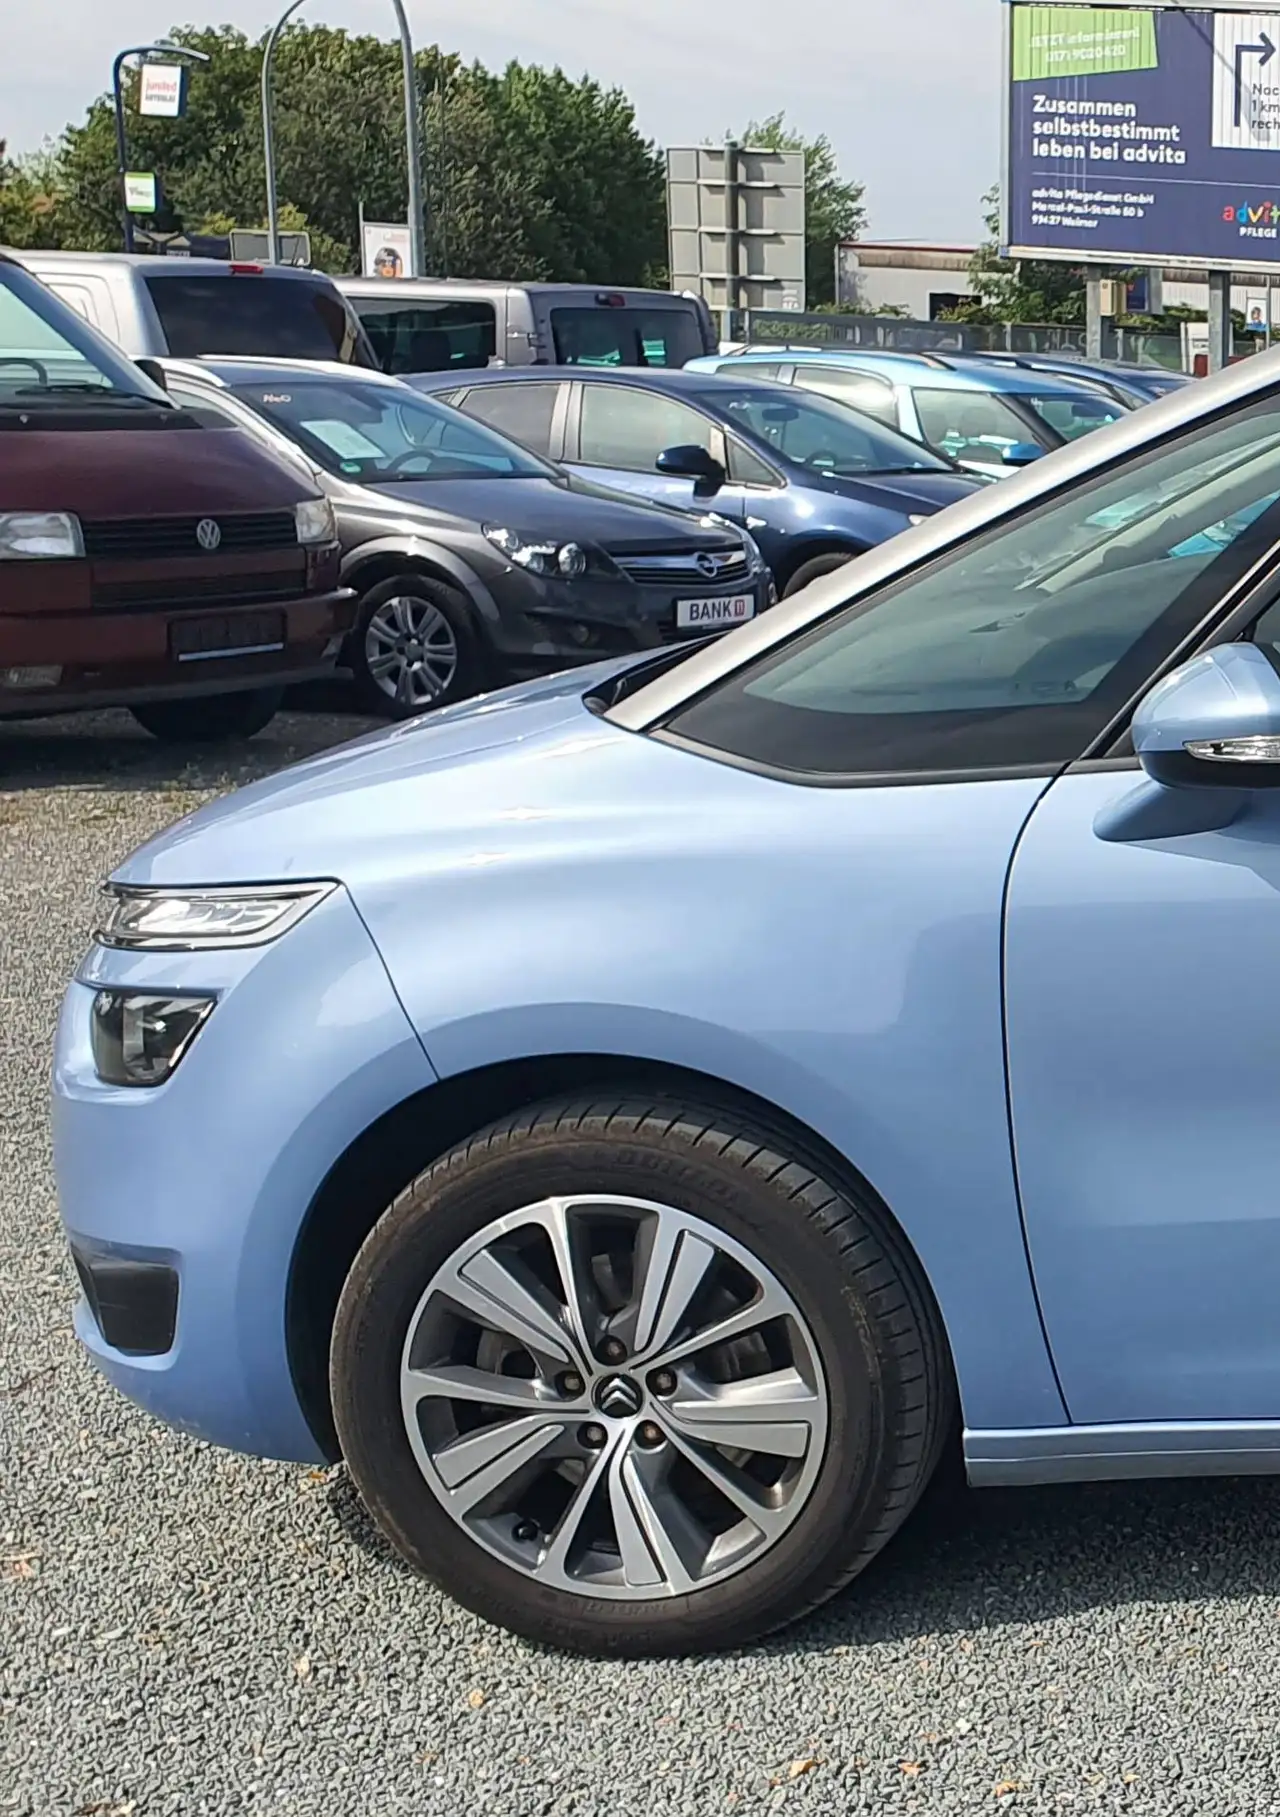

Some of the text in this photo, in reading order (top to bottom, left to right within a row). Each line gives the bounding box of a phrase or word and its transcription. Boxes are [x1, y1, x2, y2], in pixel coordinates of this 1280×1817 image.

[1032, 94, 1137, 117] Zusammen
[1251, 99, 1280, 113] 1 km
[1032, 116, 1181, 142] selbstbestimmt
[1032, 137, 1187, 165] leben bei advita
[1239, 226, 1278, 239] PFLEGE
[689, 601, 731, 620] BANK
